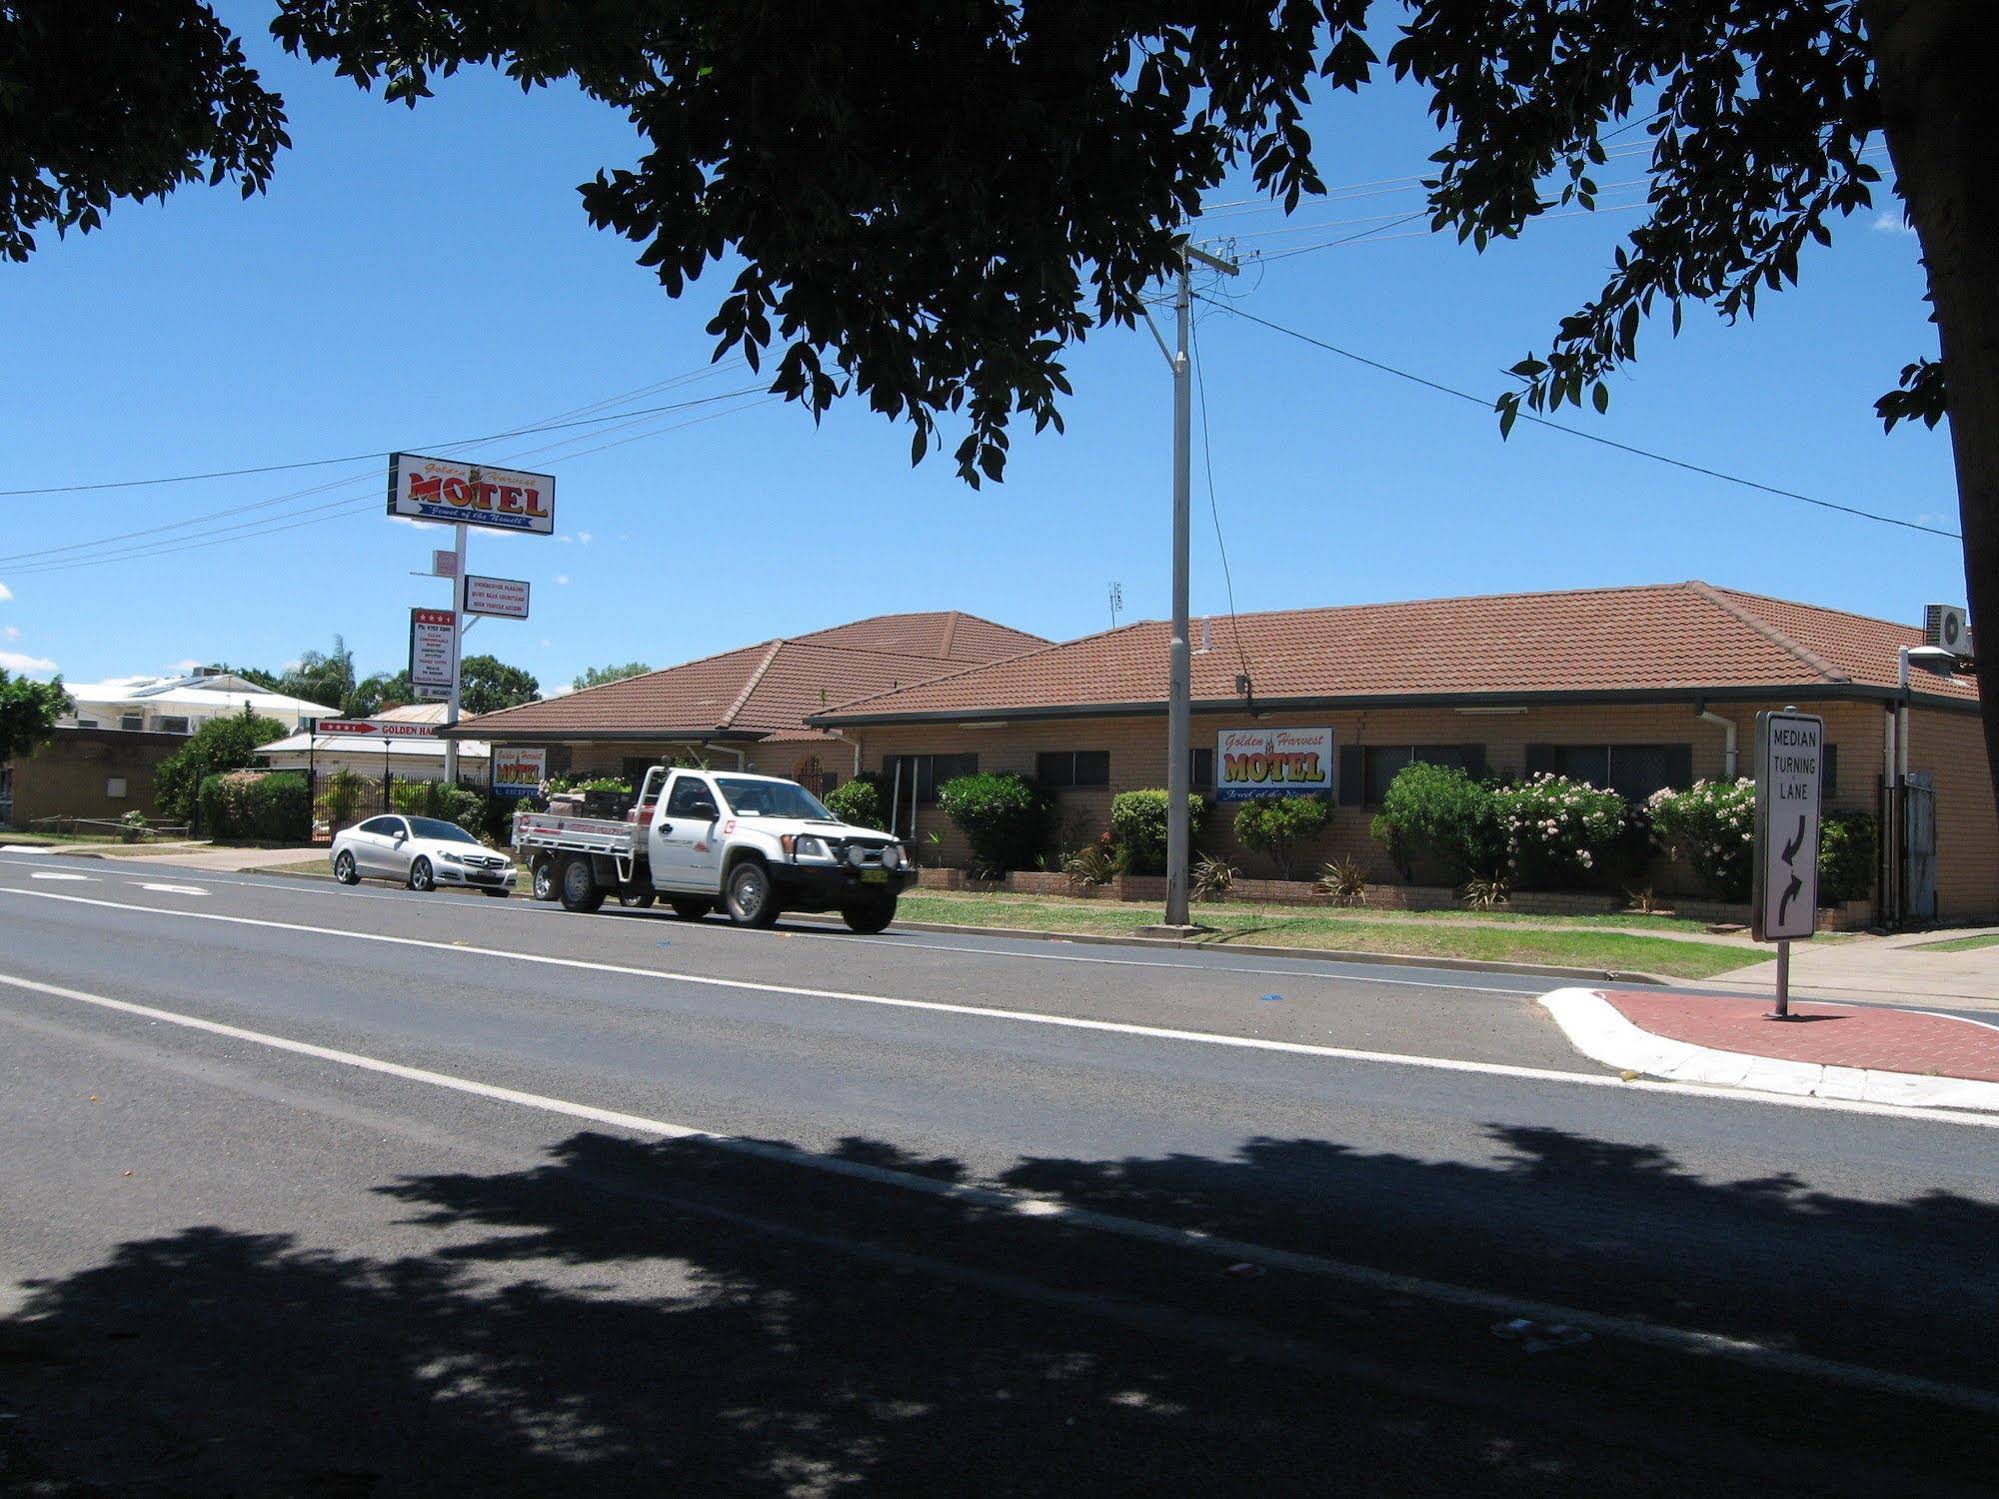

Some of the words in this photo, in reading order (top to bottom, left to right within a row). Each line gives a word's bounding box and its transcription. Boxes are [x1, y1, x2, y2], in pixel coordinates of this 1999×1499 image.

[408, 472, 549, 518] MOTEL
[382, 725, 417, 736] GOLDEN
[1774, 729, 1816, 748] MEDIAN
[1224, 733, 1264, 751] Golden
[1276, 732, 1325, 747] Harvest
[496, 763, 540, 784] MOTEL
[1224, 752, 1325, 783] MOTEL
[1774, 756, 1816, 775] TURNING
[1780, 784, 1808, 800] LANE
